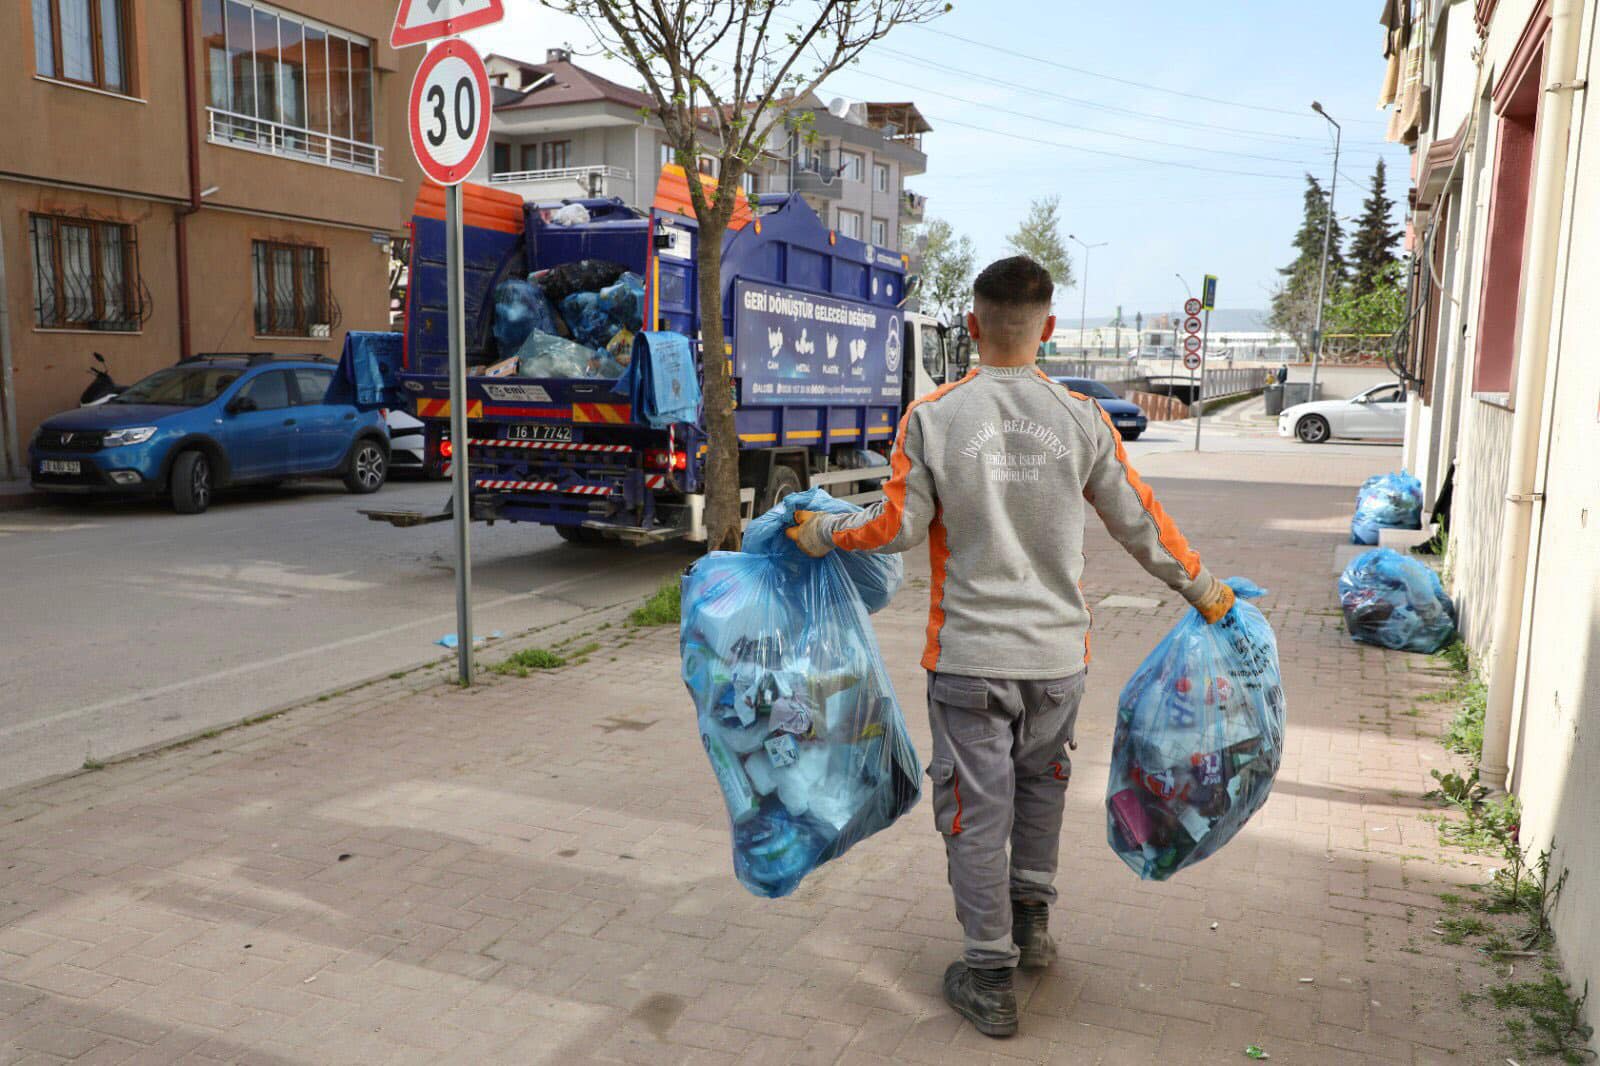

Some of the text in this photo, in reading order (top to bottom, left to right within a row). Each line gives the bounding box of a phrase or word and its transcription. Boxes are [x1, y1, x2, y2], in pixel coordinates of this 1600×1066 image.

[427, 76, 475, 147] 30
[744, 290, 767, 311] GERİ
[768, 292, 814, 321] DÖNÜŞTÜR
[814, 304, 848, 324] GELECEĞİ
[516, 426, 570, 440] 16 Y 7742
[1003, 419, 1072, 460] BELEDİYESİ
